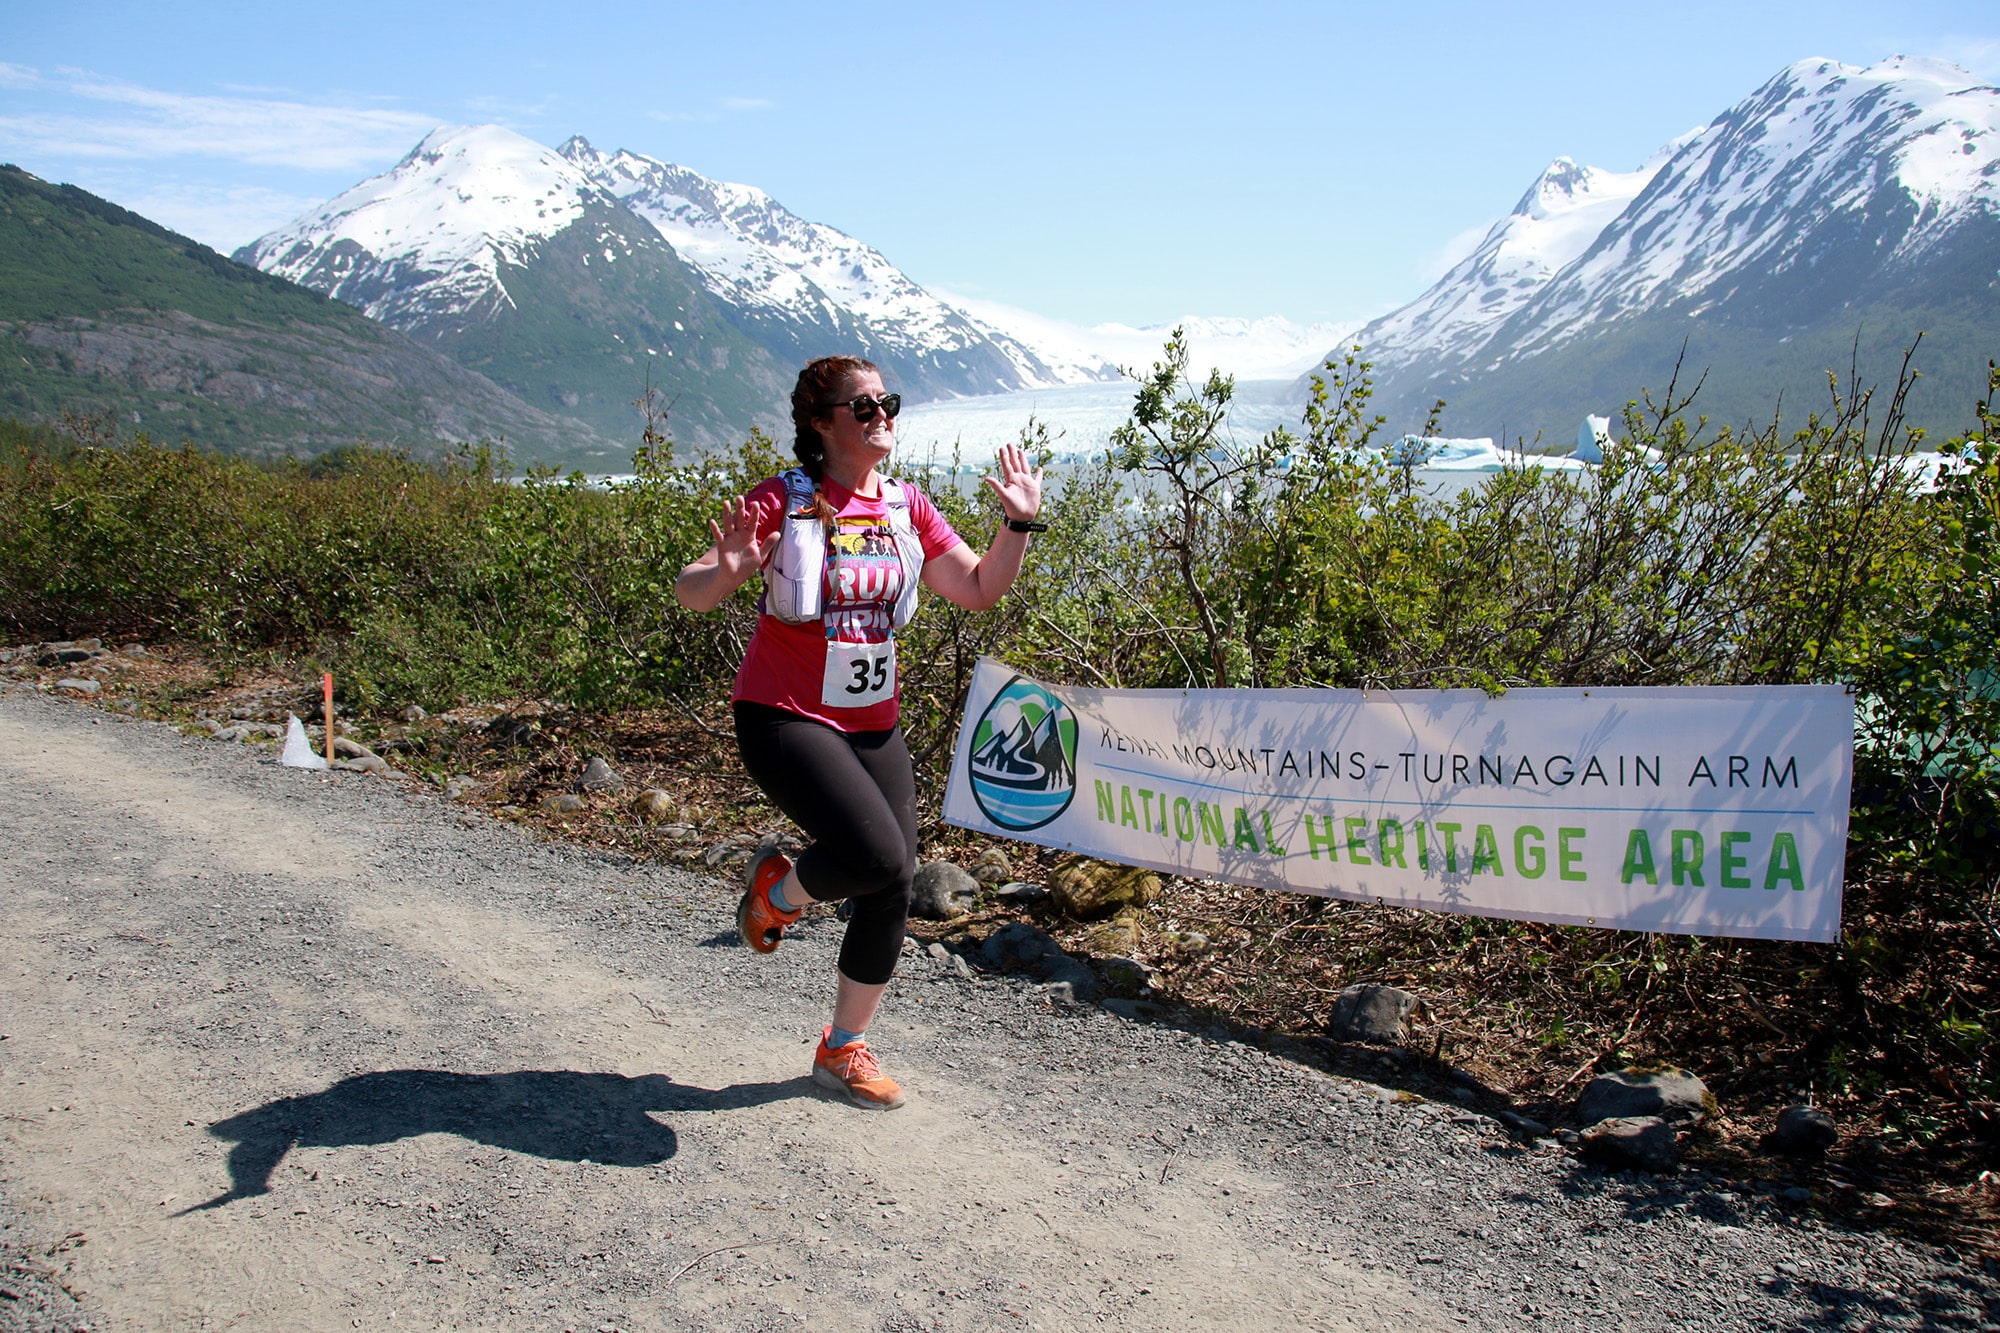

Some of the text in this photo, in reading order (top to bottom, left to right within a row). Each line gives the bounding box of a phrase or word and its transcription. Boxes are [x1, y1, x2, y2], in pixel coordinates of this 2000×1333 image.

[827, 567, 901, 600] RUN
[845, 655, 889, 694] 35
[1100, 726, 1799, 788] KENAI MOUNTAINS-TURNAGAIN ARM
[1094, 779, 1805, 891] NATIONAL HERITAGE AREA
